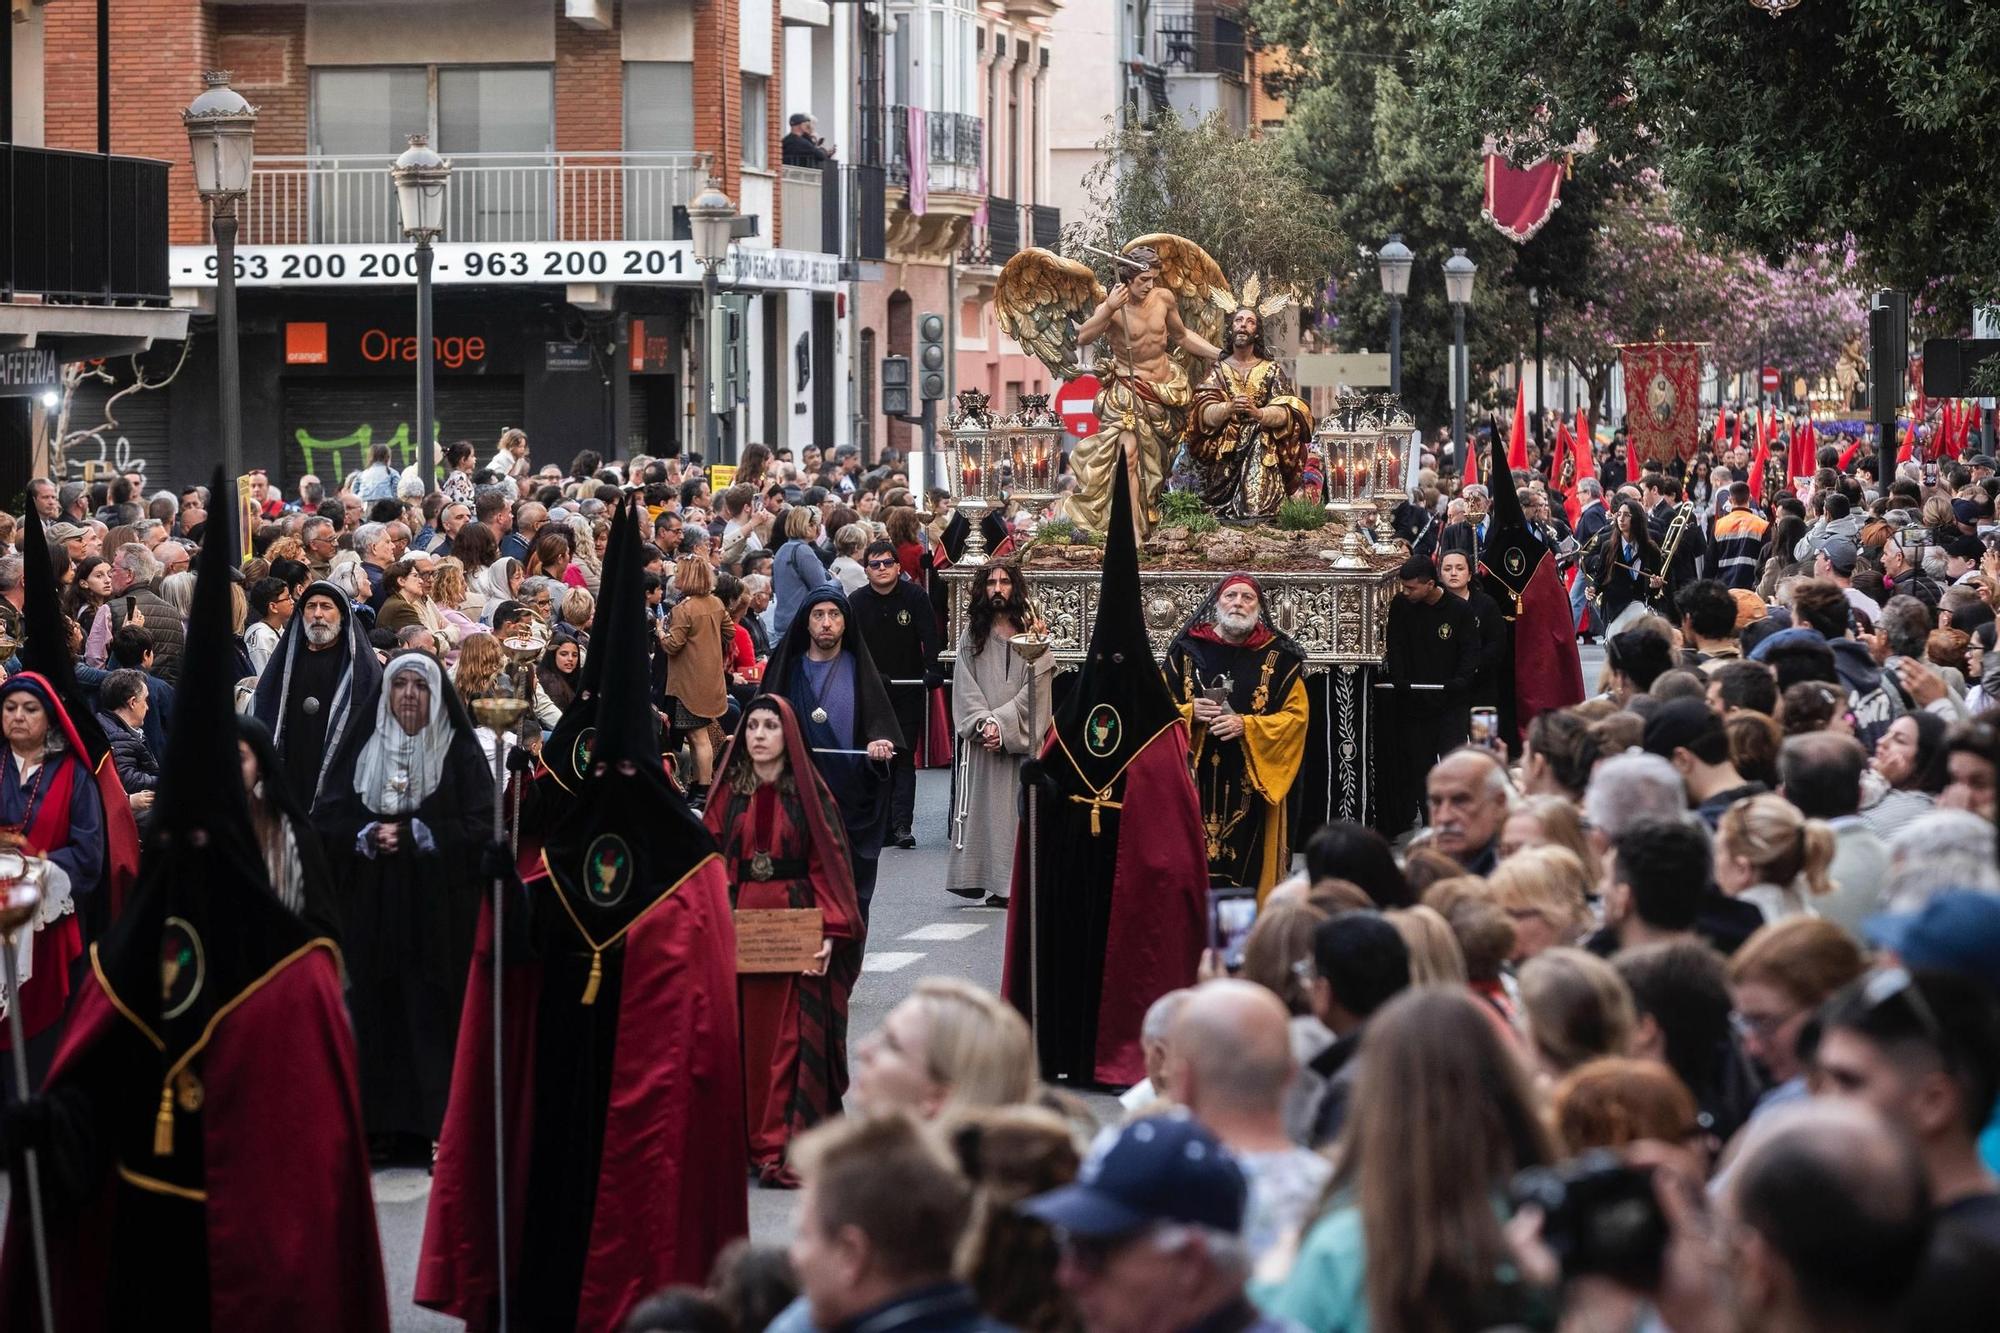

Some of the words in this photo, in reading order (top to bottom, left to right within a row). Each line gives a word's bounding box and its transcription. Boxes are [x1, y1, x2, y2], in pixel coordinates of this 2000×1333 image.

[204, 254, 269, 280] 963
[281, 254, 346, 279] 200
[359, 253, 419, 278] 200
[464, 252, 529, 277] 963
[543, 251, 607, 276] 200
[623, 250, 683, 275] 201
[288, 352, 322, 363] orange
